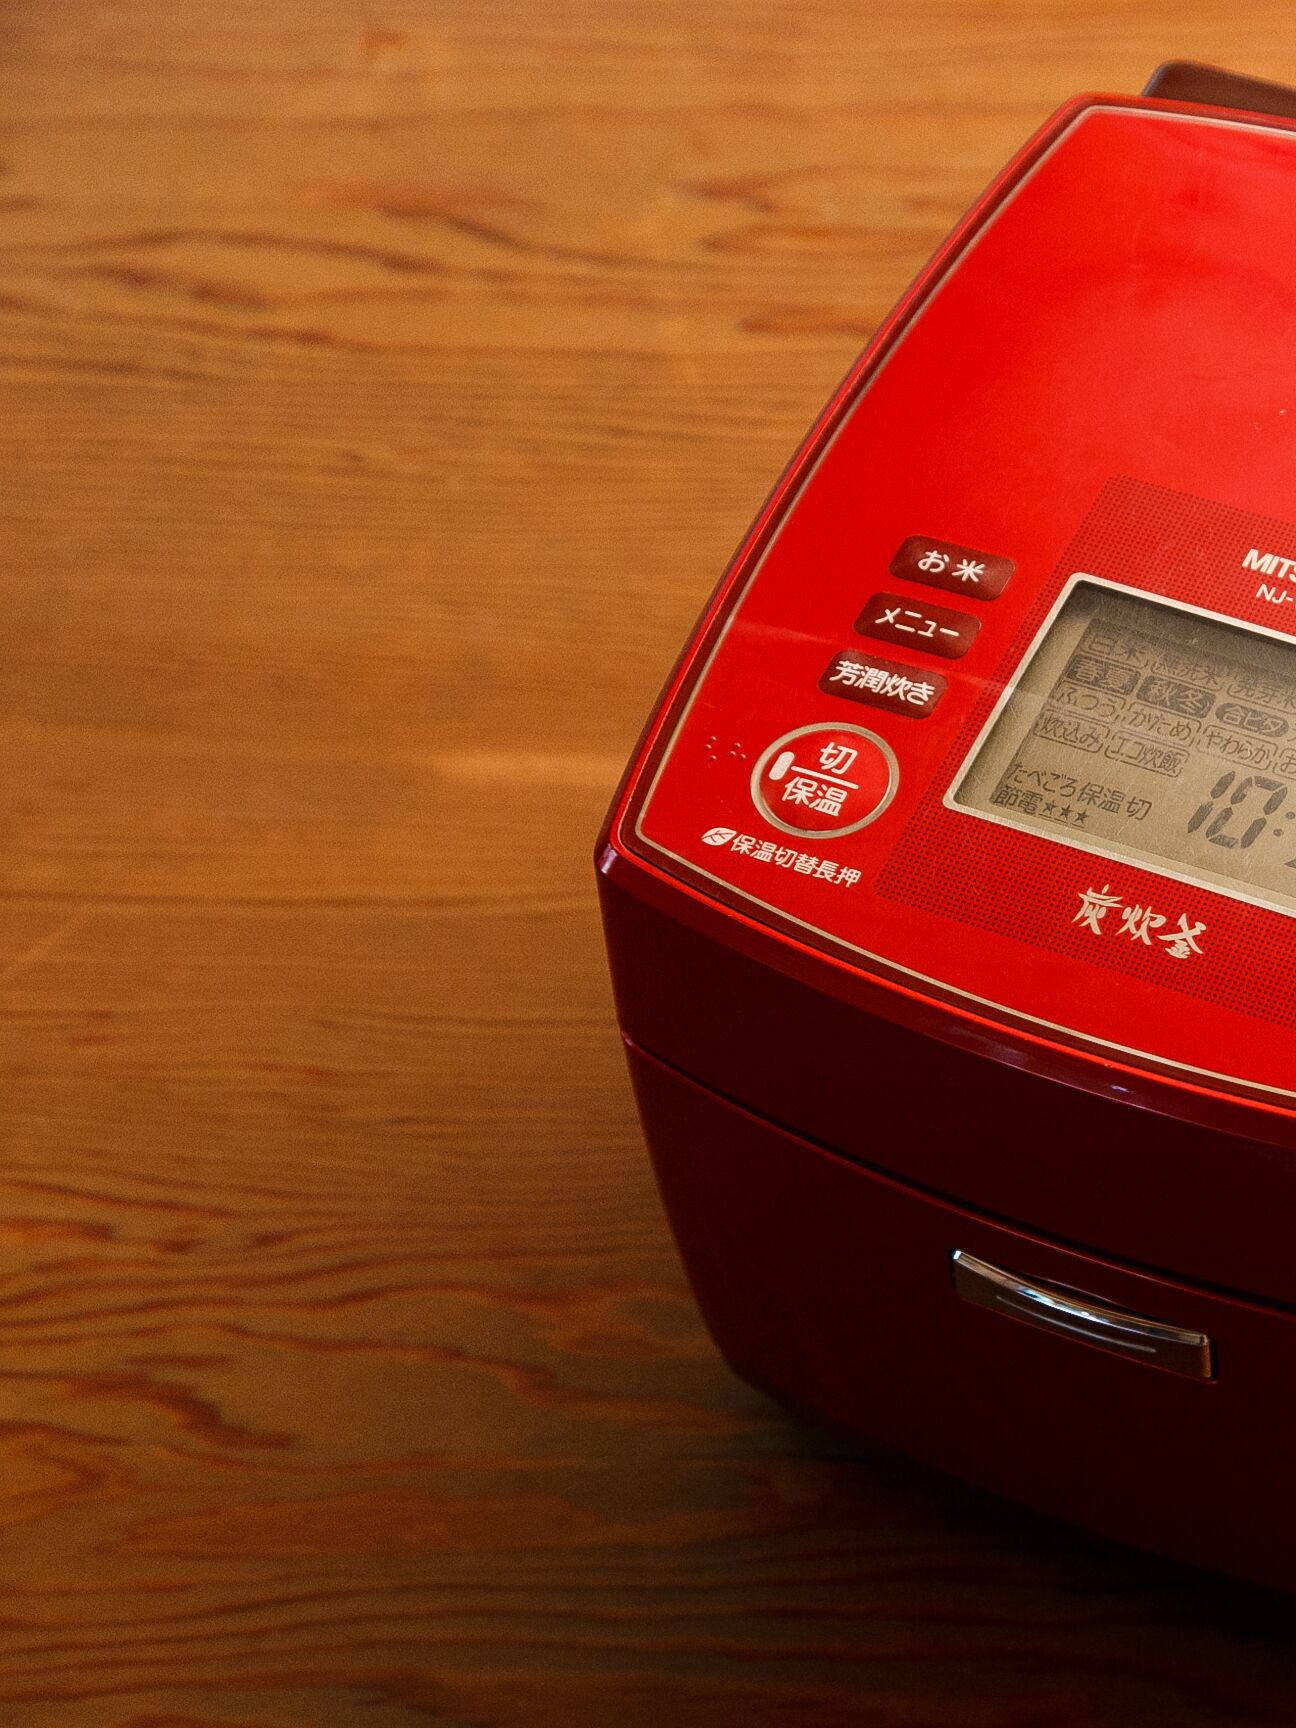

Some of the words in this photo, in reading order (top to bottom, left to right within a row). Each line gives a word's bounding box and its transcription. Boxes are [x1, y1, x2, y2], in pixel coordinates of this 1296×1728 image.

[917, 550, 986, 583] お米
[875, 607, 960, 638] メニュー
[829, 660, 936, 707] 芳潤炊き
[1039, 715, 1103, 748] 炊込み
[1111, 735, 1183, 774] エコ炊飯
[1057, 686, 1118, 720] ふつう
[1127, 708, 1193, 743] かため
[1205, 730, 1271, 766] やわらか
[819, 742, 858, 776] 切
[782, 775, 849, 818] 保温
[729, 832, 863, 889] 保温切替長押
